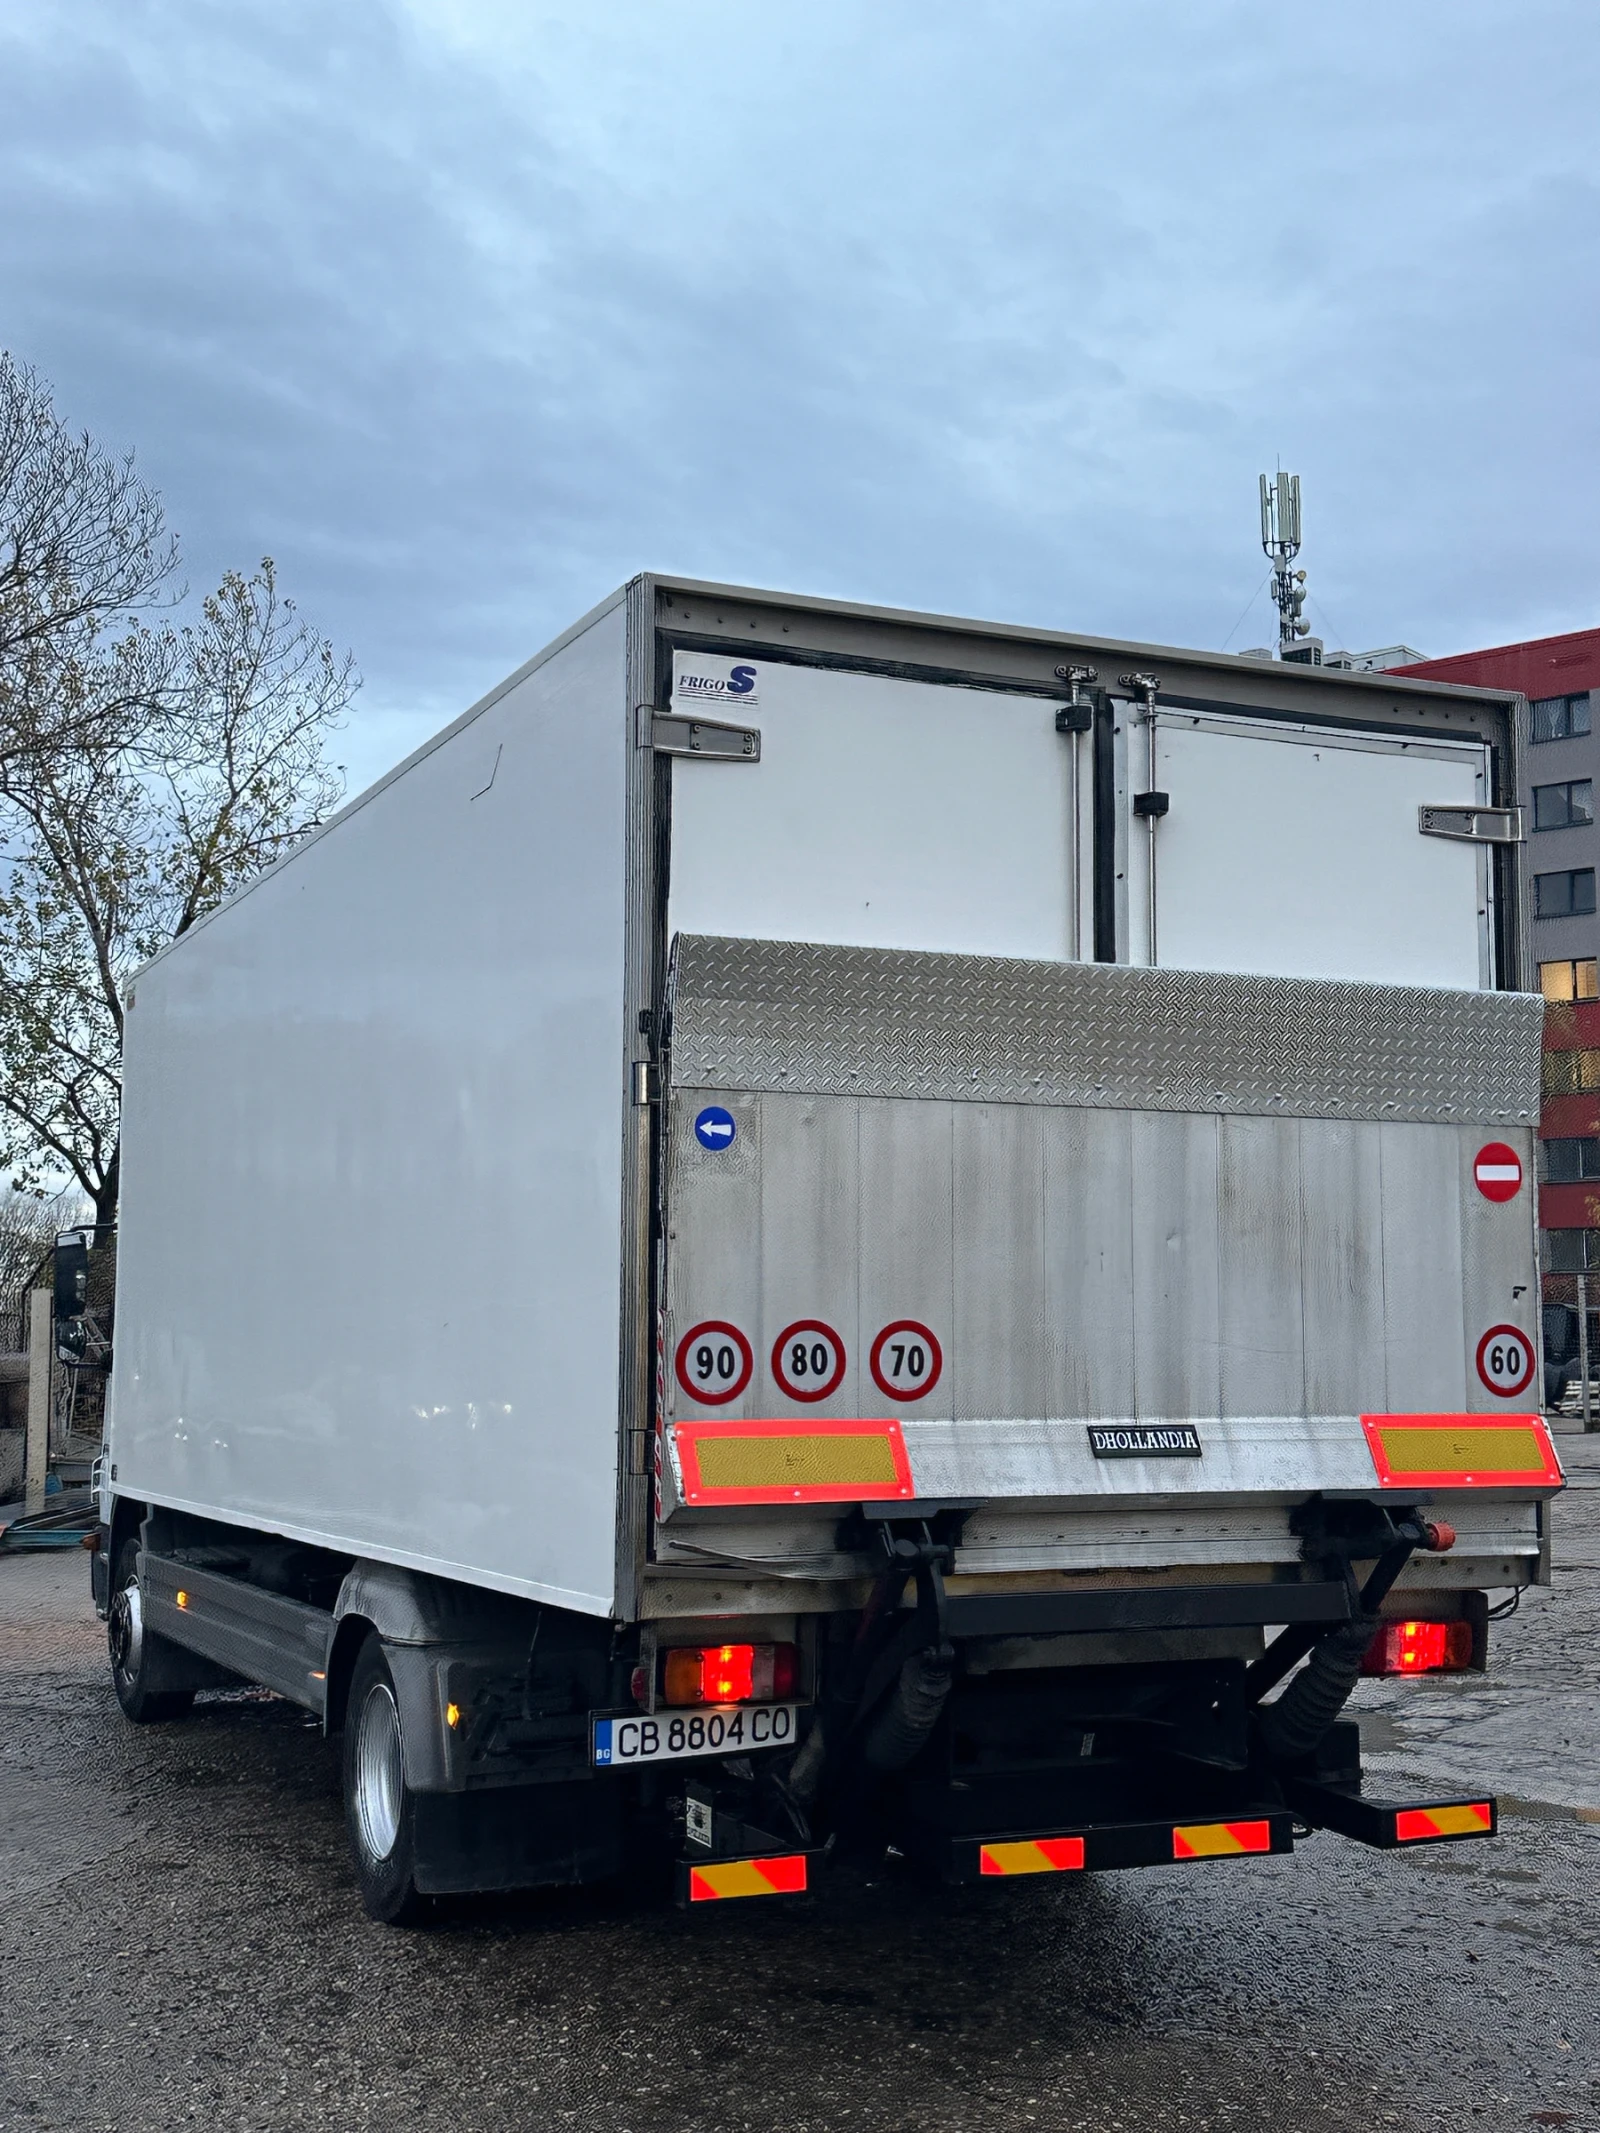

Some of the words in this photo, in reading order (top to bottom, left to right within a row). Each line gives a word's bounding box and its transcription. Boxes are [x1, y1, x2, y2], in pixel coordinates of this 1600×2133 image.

[696, 1345, 735, 1380] 90
[791, 1343, 828, 1376] 80
[890, 1345, 925, 1377] 70
[1491, 1345, 1520, 1375] 60
[1093, 1431, 1198, 1449] DHOLLANDIA
[618, 1721, 660, 1757] CB
[668, 1711, 743, 1752] 8804
[752, 1707, 790, 1742] CO
[596, 1748, 611, 1760] BG
